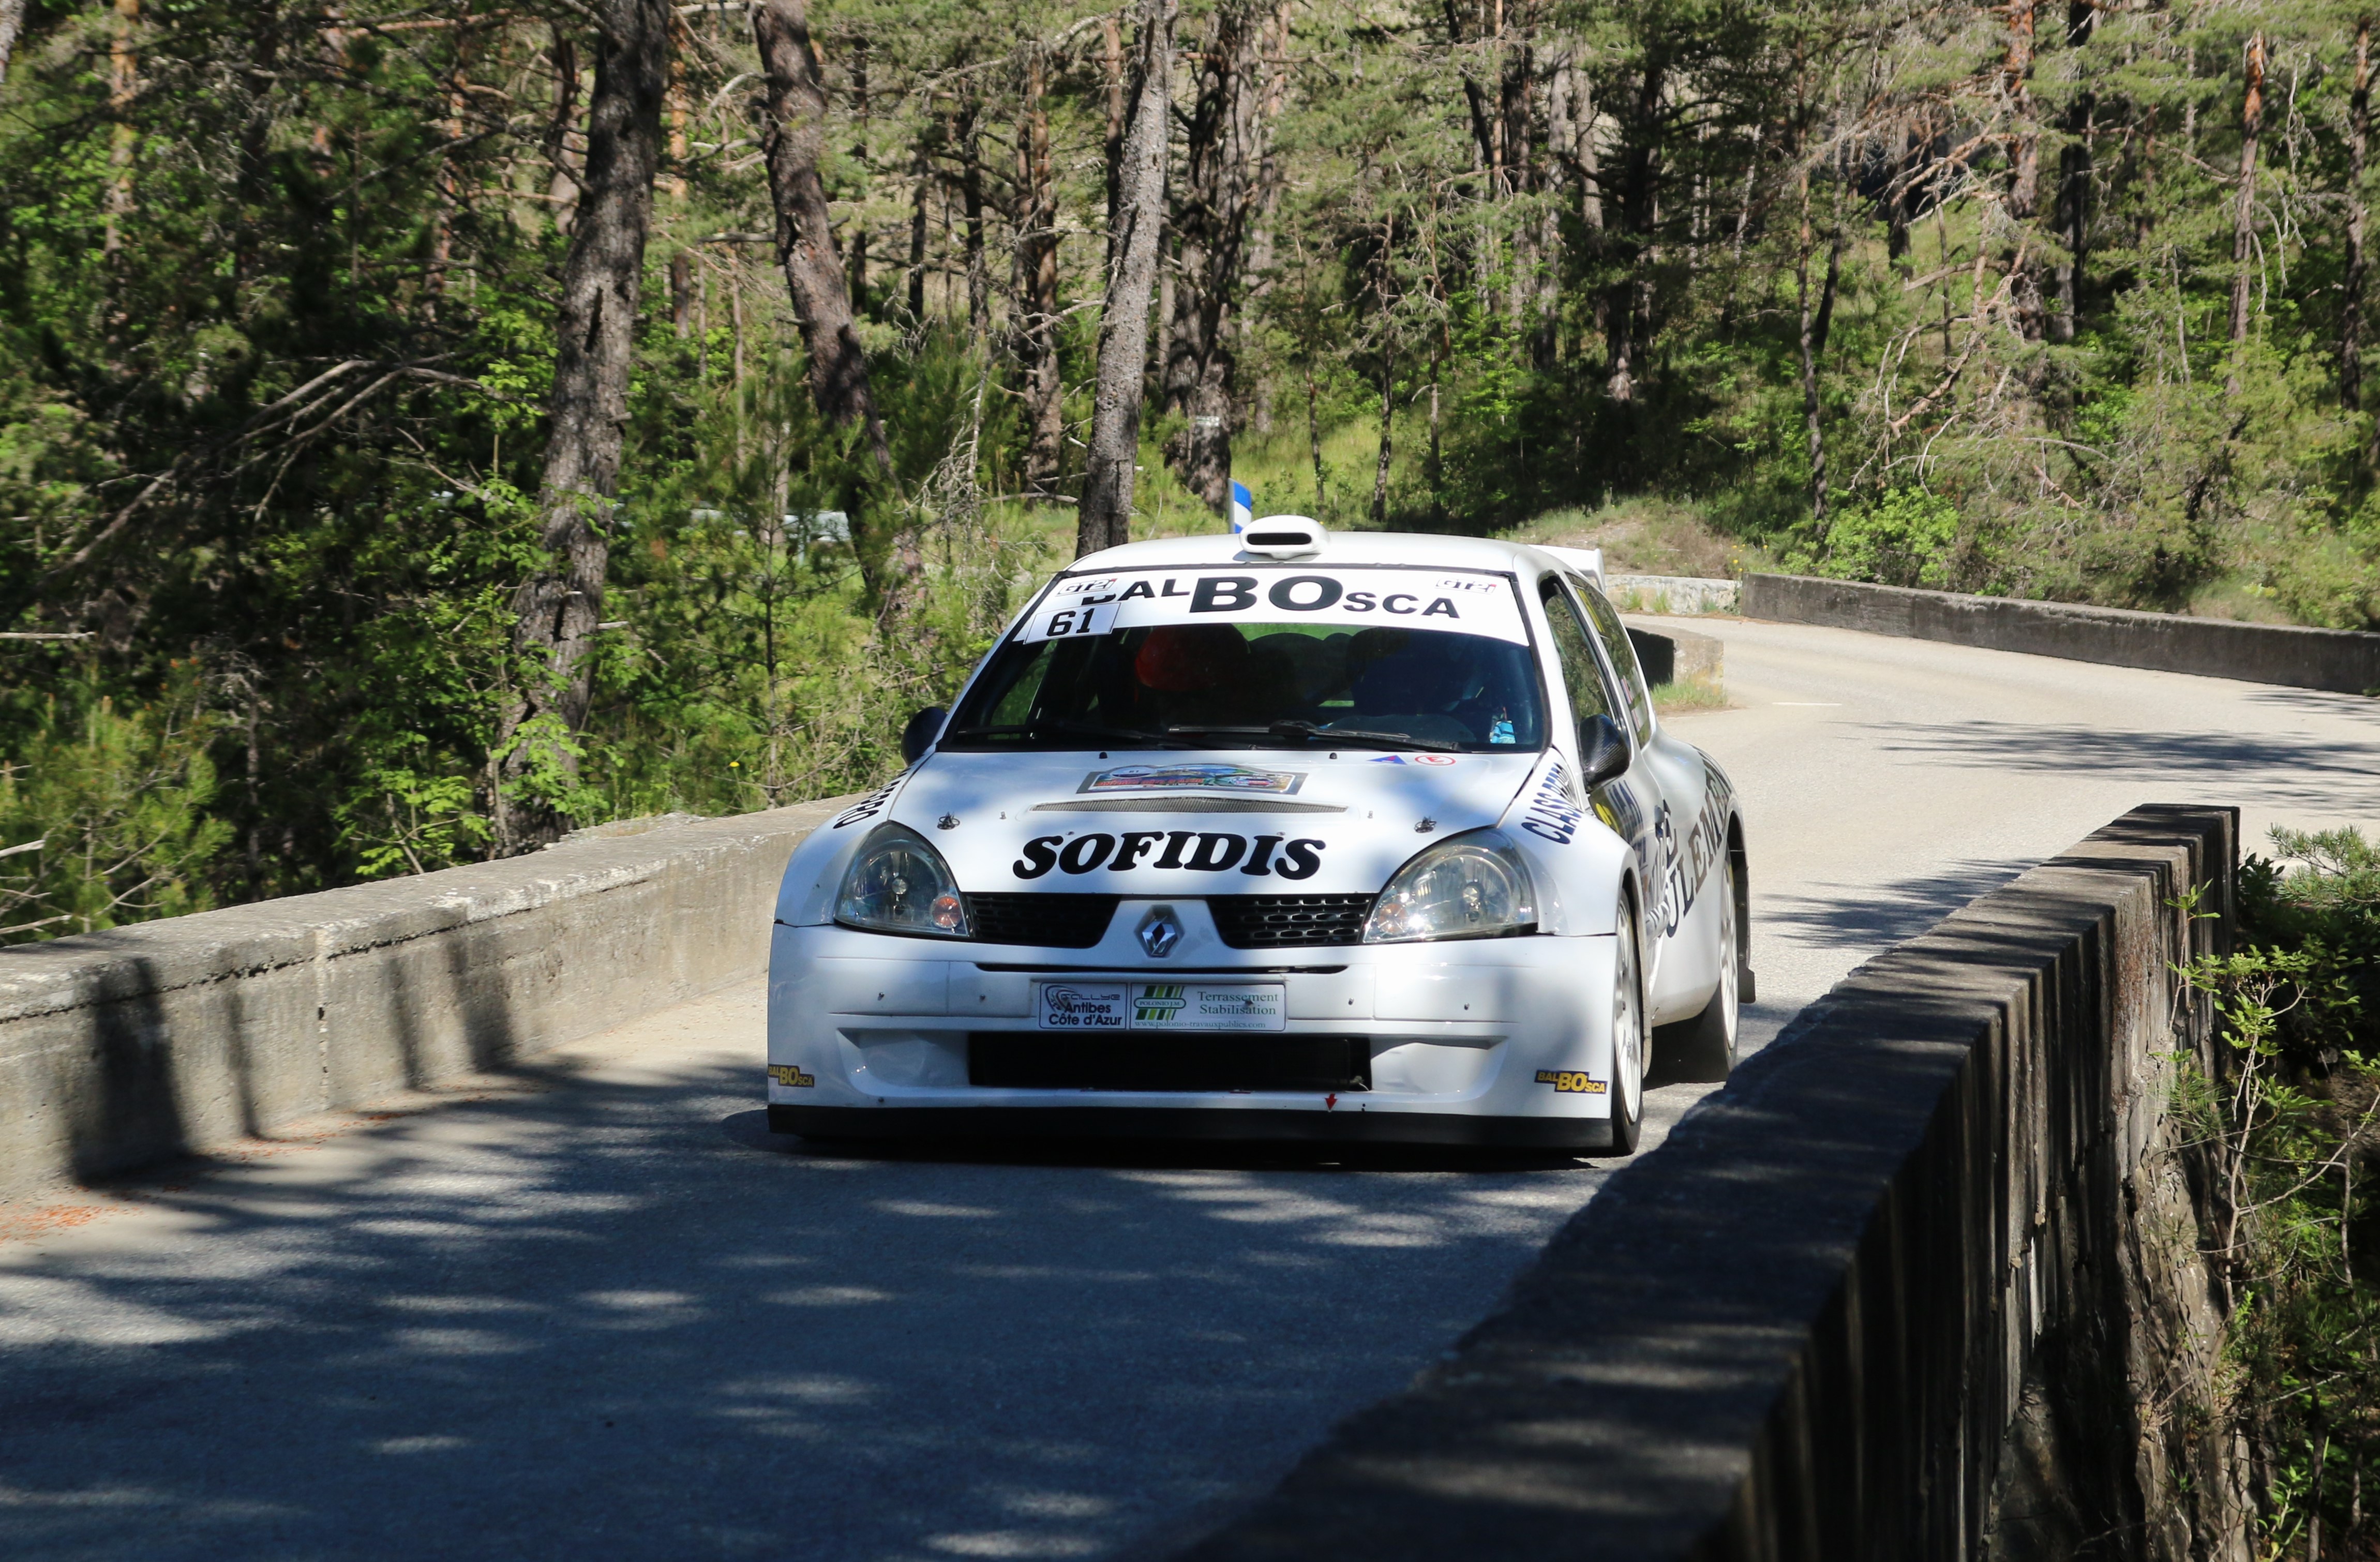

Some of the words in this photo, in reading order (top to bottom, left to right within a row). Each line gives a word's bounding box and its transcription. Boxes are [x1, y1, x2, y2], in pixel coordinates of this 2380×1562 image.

[1046, 608, 1095, 636] 61
[1521, 792, 1585, 844] CLASS
[1012, 831, 1326, 880] SOFIDIS
[1197, 991, 1278, 1002] Terrassement
[1065, 1002, 1111, 1013] Antibes
[1200, 1004, 1276, 1015] Stabilisation
[1049, 1013, 1080, 1025] Côte
[1084, 1015, 1122, 1025] d'Azur
[1537, 1072, 1605, 1093] BALBOSCA
